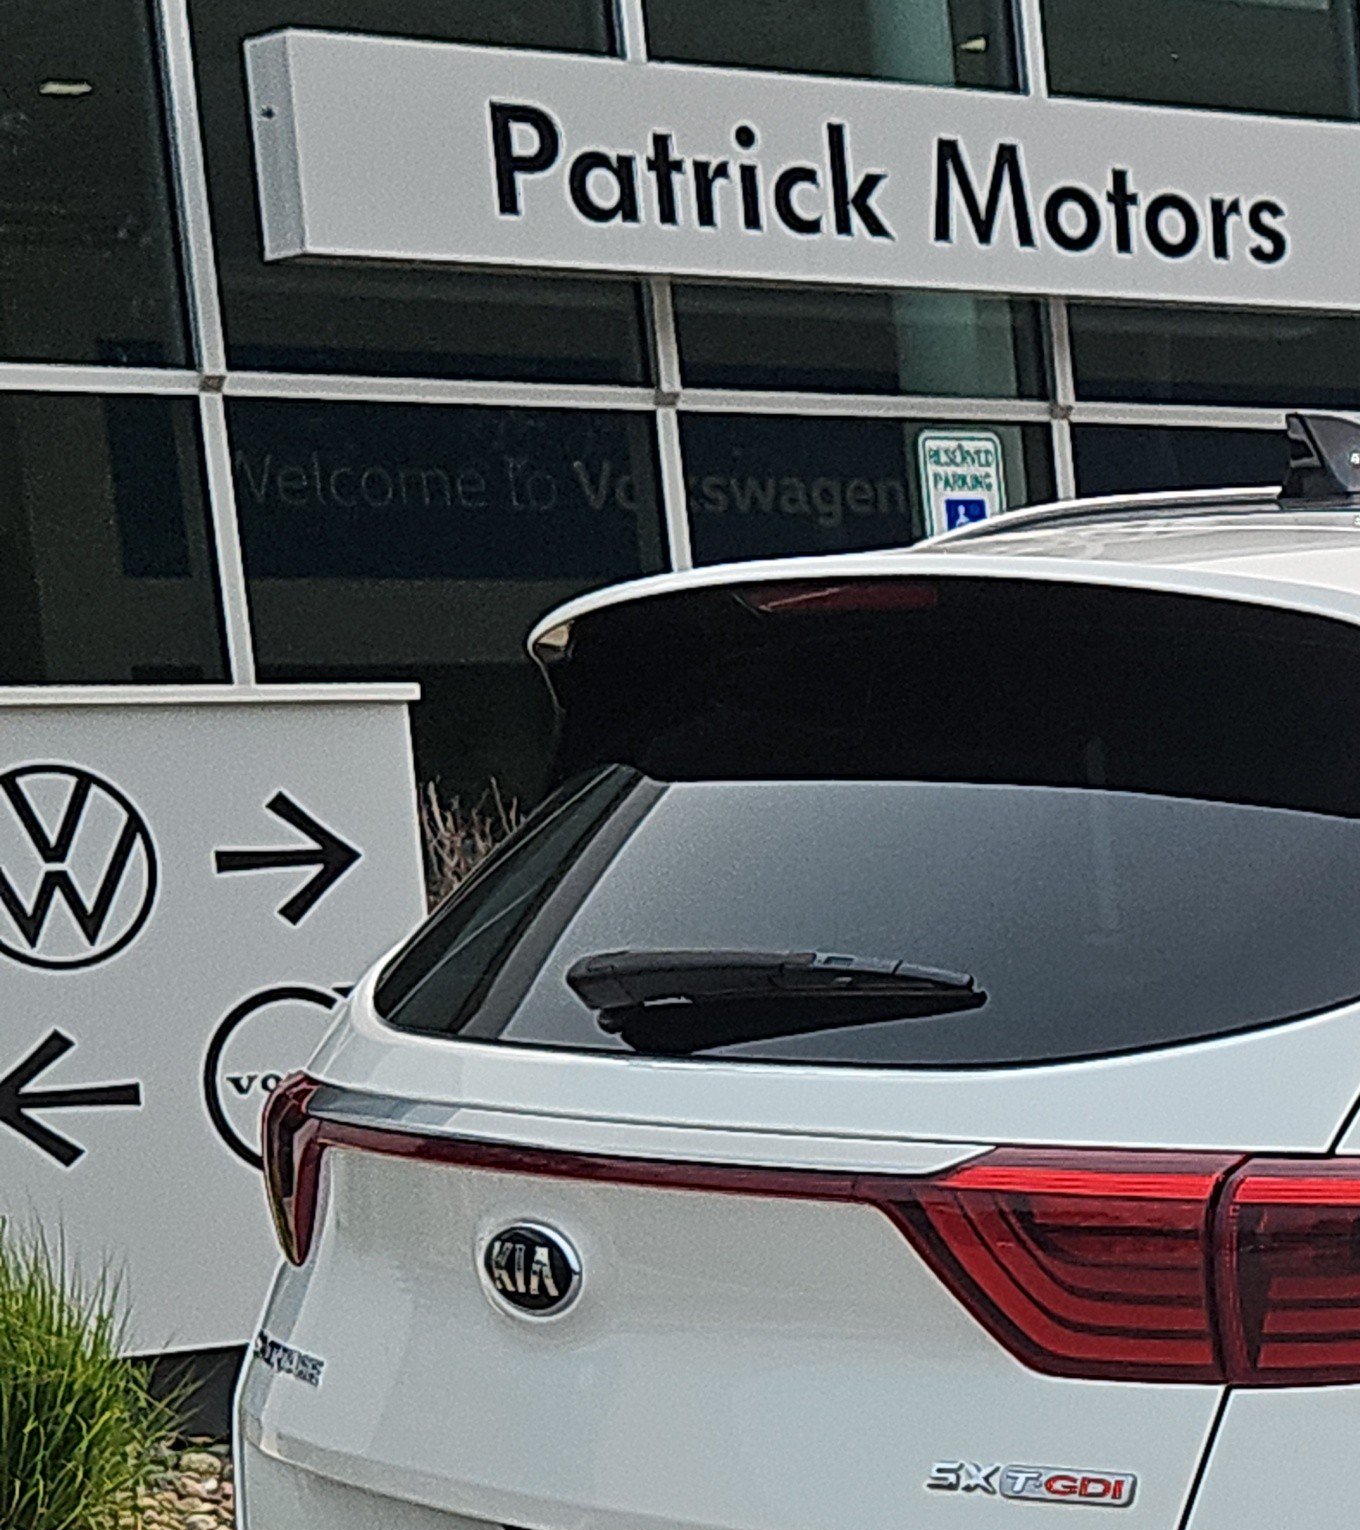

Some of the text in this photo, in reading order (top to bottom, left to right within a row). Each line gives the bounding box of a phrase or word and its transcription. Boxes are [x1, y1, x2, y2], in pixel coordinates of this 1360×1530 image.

[490, 100, 1286, 263] Patrick Motors
[504, 453, 557, 509] to
[572, 460, 906, 526] Voswagen
[933, 472, 993, 491] PARKING
[491, 1240, 560, 1297] KIA
[927, 1460, 1000, 1495] SX
